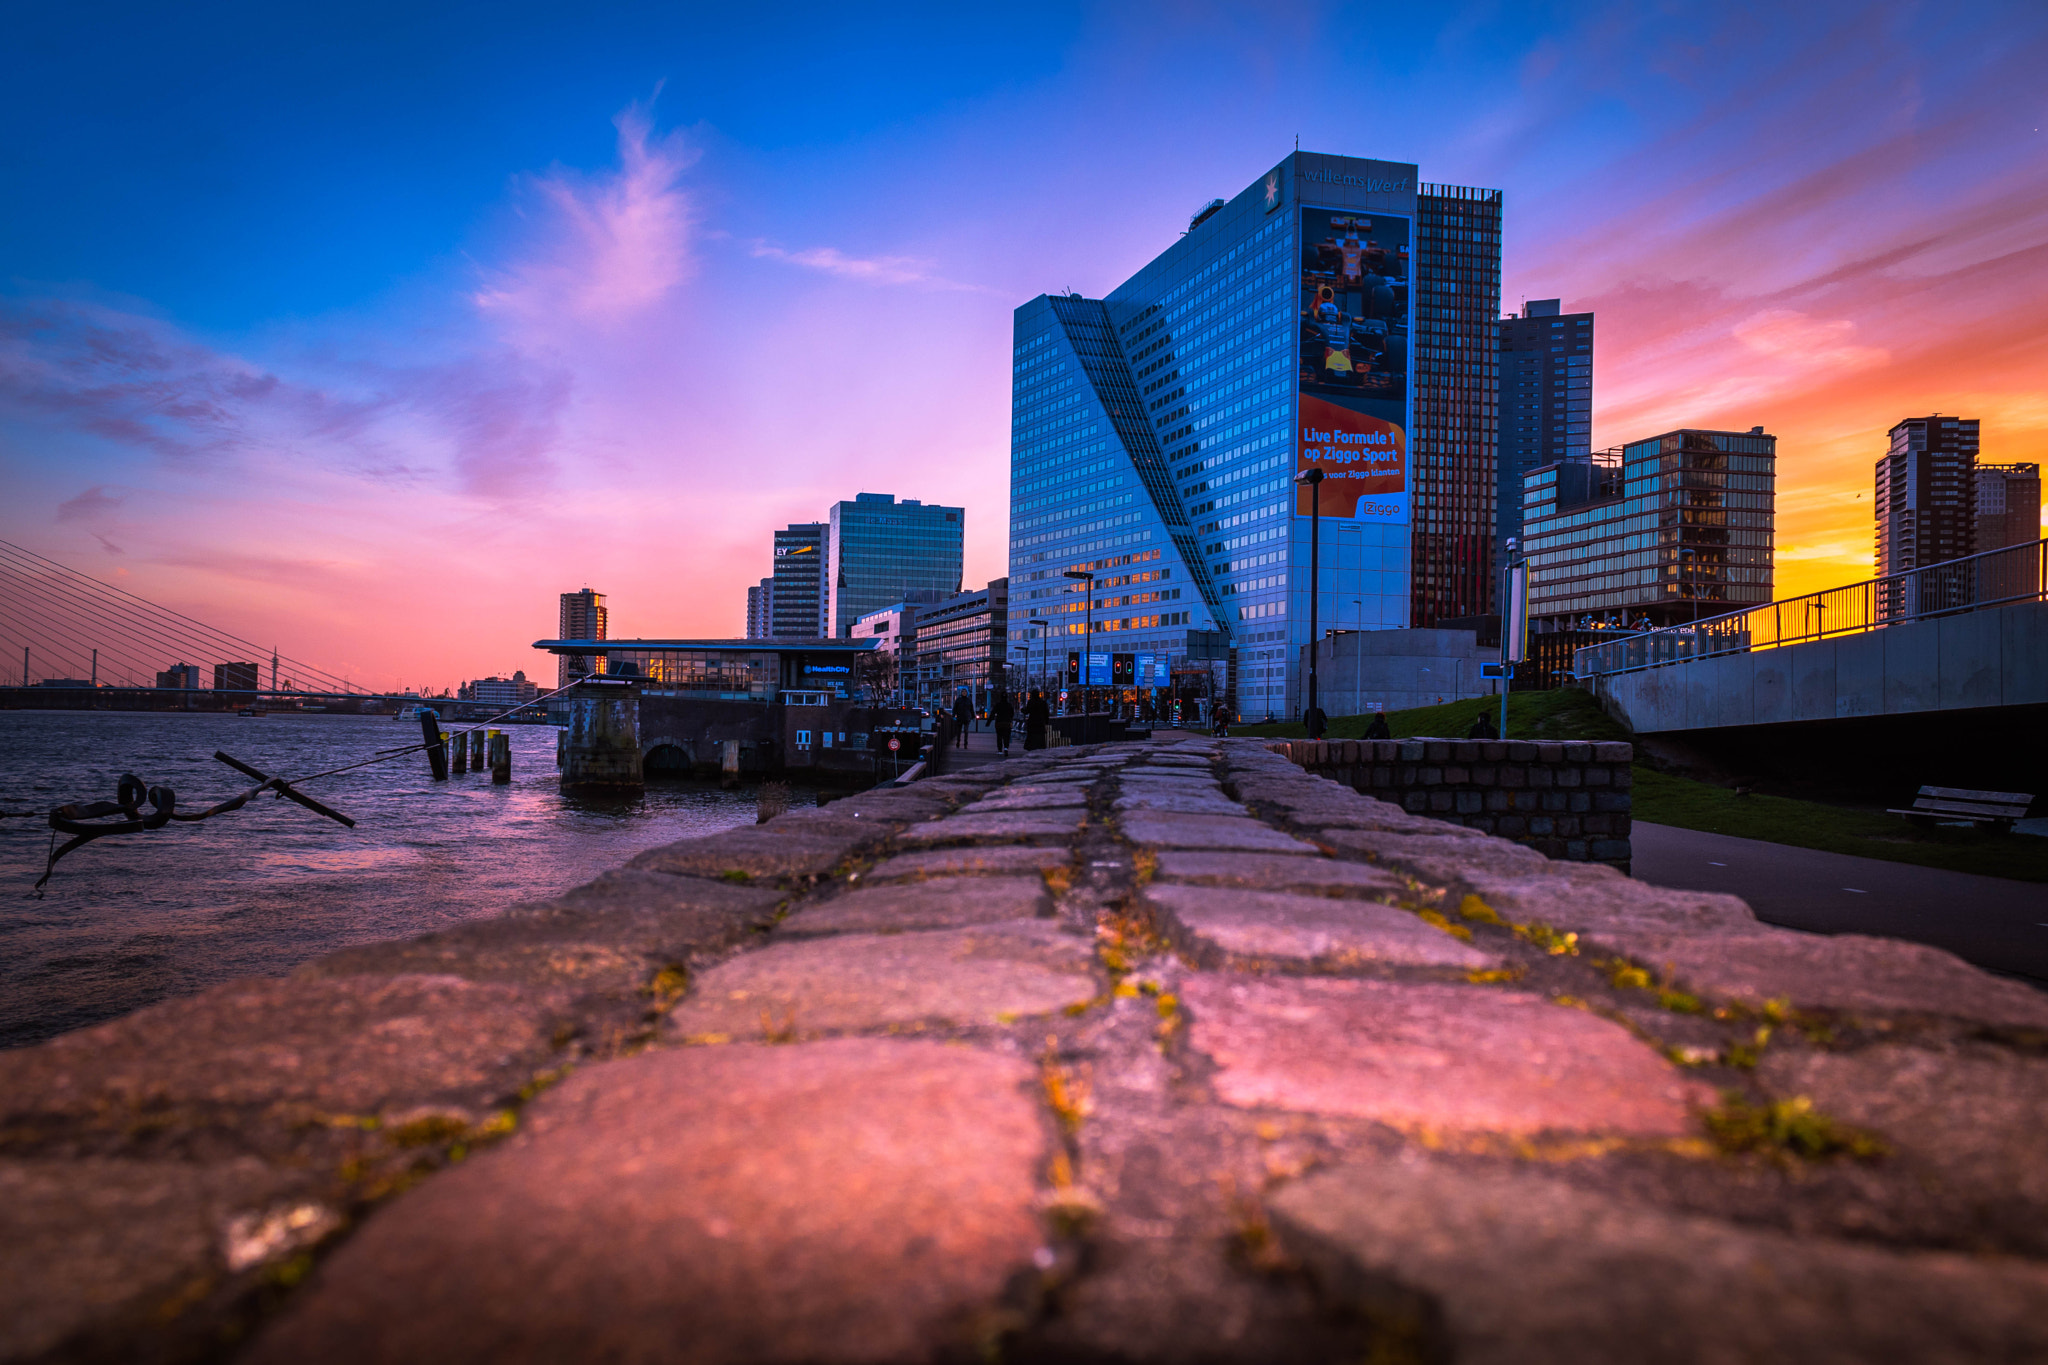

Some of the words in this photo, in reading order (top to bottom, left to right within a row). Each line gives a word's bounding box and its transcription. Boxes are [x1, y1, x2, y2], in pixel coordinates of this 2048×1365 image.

[1303, 428, 1331, 442] Live
[1333, 429, 1387, 445] Formule
[1389, 432, 1395, 444] 1
[1304, 448, 1320, 462] op
[1323, 446, 1360, 463] Ziggo
[1362, 448, 1398, 464] Sport
[1348, 470, 1370, 479] Ziggo
[1371, 468, 1400, 477] klanten
[776, 548, 788, 556] EY
[812, 665, 850, 674] HealthCity
